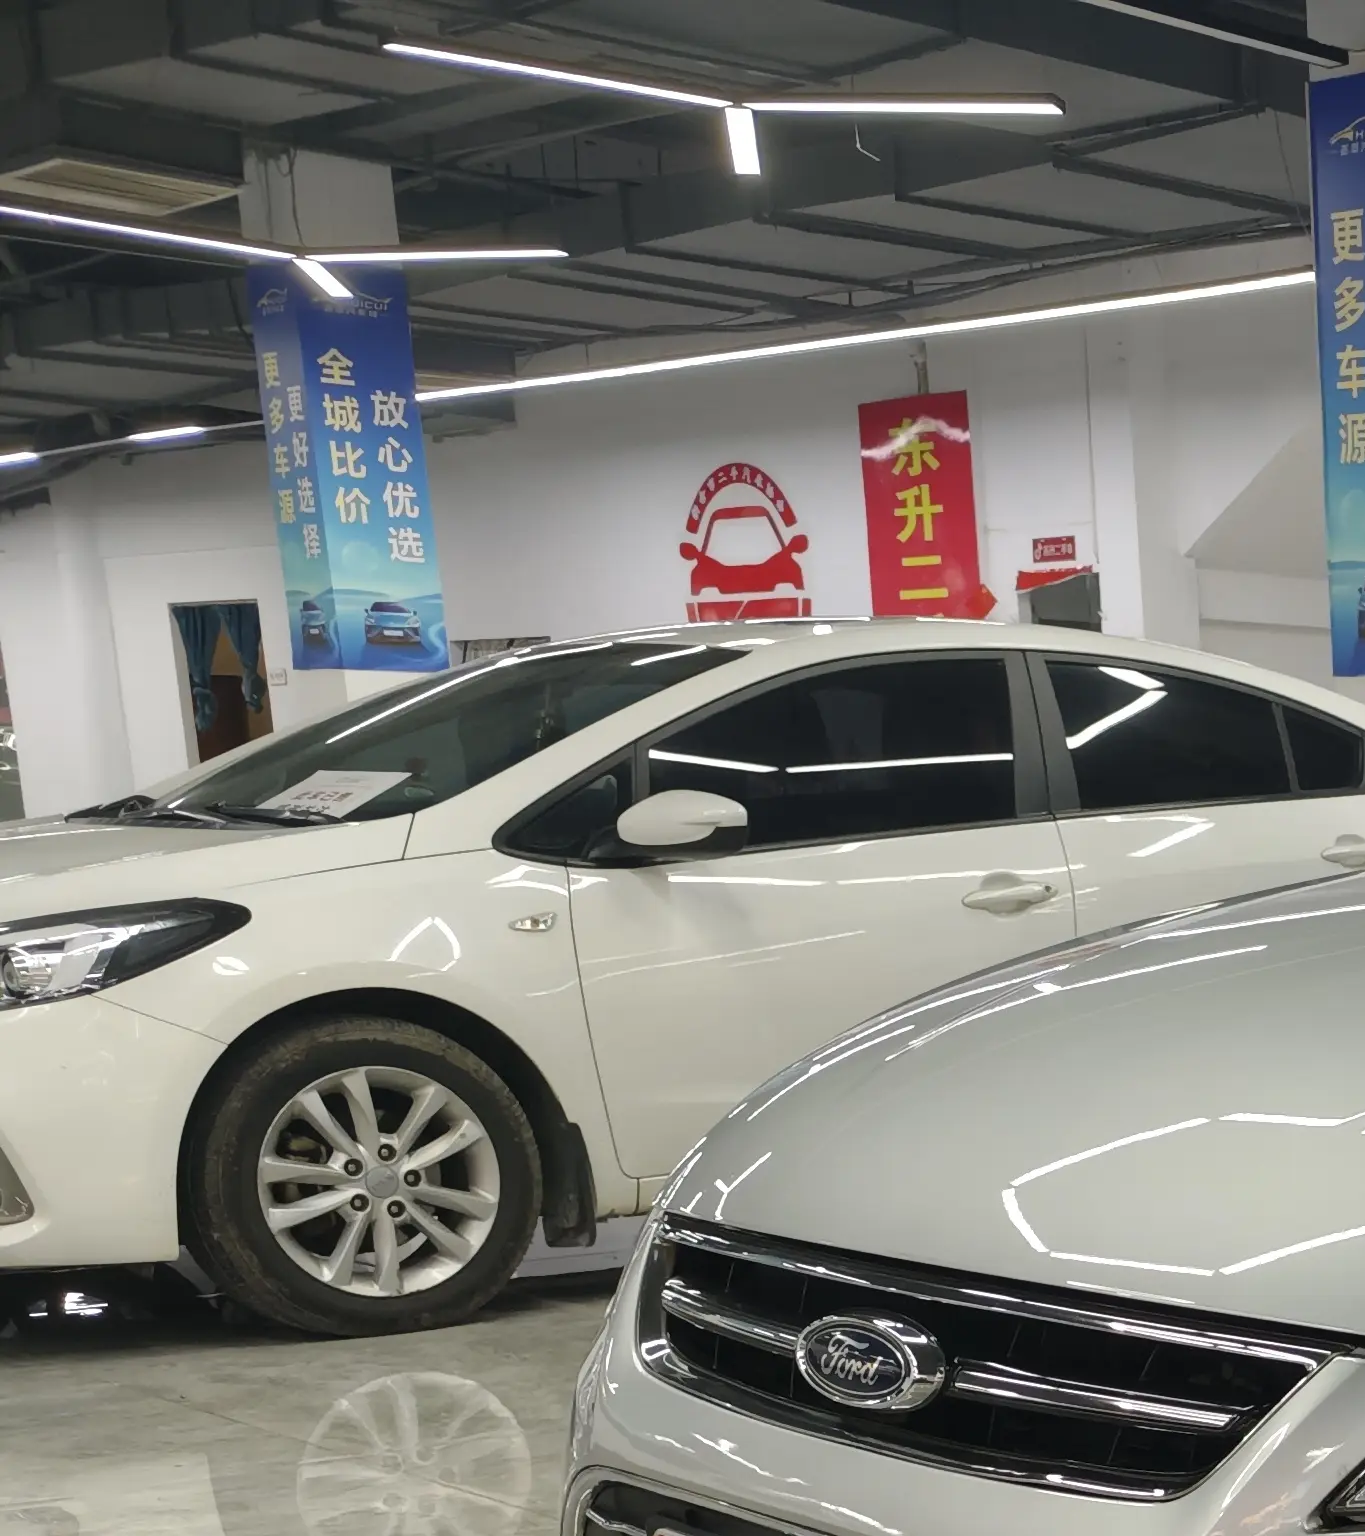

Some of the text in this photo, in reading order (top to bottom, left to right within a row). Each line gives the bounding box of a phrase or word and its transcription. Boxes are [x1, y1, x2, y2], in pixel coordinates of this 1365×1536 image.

[262, 351, 296, 525] 更多车源
[287, 385, 321, 559] 更好选择
[317, 347, 371, 525] 全城比价
[370, 390, 425, 563] 放心优选
[888, 417, 948, 617] 东升二
[821, 1331, 880, 1386] Ford
